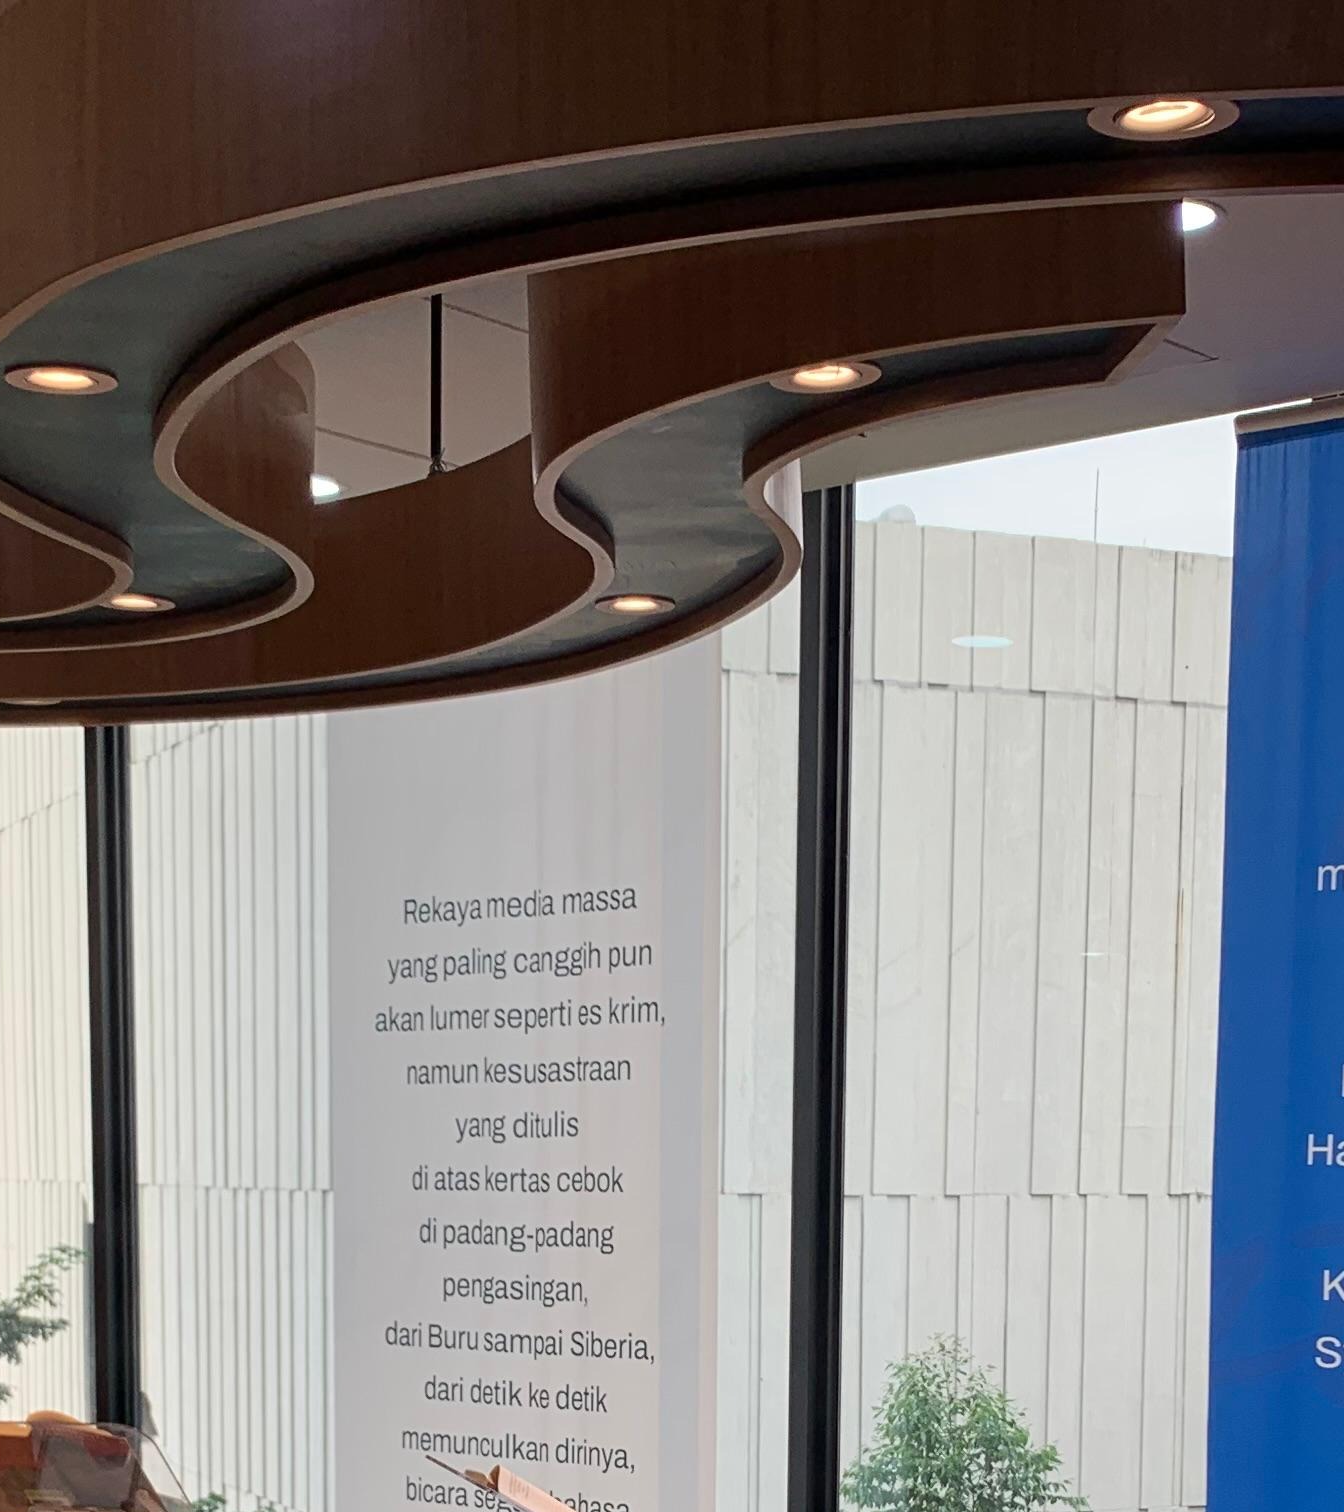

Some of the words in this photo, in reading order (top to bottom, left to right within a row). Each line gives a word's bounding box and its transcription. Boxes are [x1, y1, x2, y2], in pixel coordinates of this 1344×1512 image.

[404, 895, 483, 927] Rekaya
[486, 889, 556, 918] media
[562, 887, 638, 915] massa
[387, 954, 438, 985] yang
[443, 947, 507, 982] paling
[513, 941, 601, 977] canggih
[608, 944, 652, 974] pun
[375, 1006, 424, 1033] akan
[430, 1004, 490, 1031] lumer
[493, 999, 572, 1035] seperti
[578, 1004, 602, 1026] es
[608, 995, 665, 1026] krim,
[407, 1063, 479, 1085] namun
[484, 1056, 631, 1084] kesusastraan
[455, 1115, 506, 1144] yang
[512, 1110, 579, 1139] ditulis
[412, 1164, 429, 1191] di
[434, 1166, 481, 1192] atas
[484, 1165, 551, 1193] kertas
[556, 1165, 624, 1193] cebok
[419, 1217, 437, 1244] di
[443, 1218, 615, 1255] padang-padang
[443, 1274, 588, 1308] pengasingan,
[384, 1320, 422, 1348] dari
[428, 1323, 479, 1351] Buru
[483, 1329, 563, 1361] sampai
[570, 1330, 655, 1365] Siberia,
[424, 1375, 464, 1402] dari
[470, 1378, 523, 1407] detik
[528, 1381, 550, 1409] ke
[555, 1383, 608, 1413] detik
[402, 1430, 549, 1463] memunculkan
[555, 1437, 635, 1474] dirinya,
[406, 1475, 469, 1507] bicara
